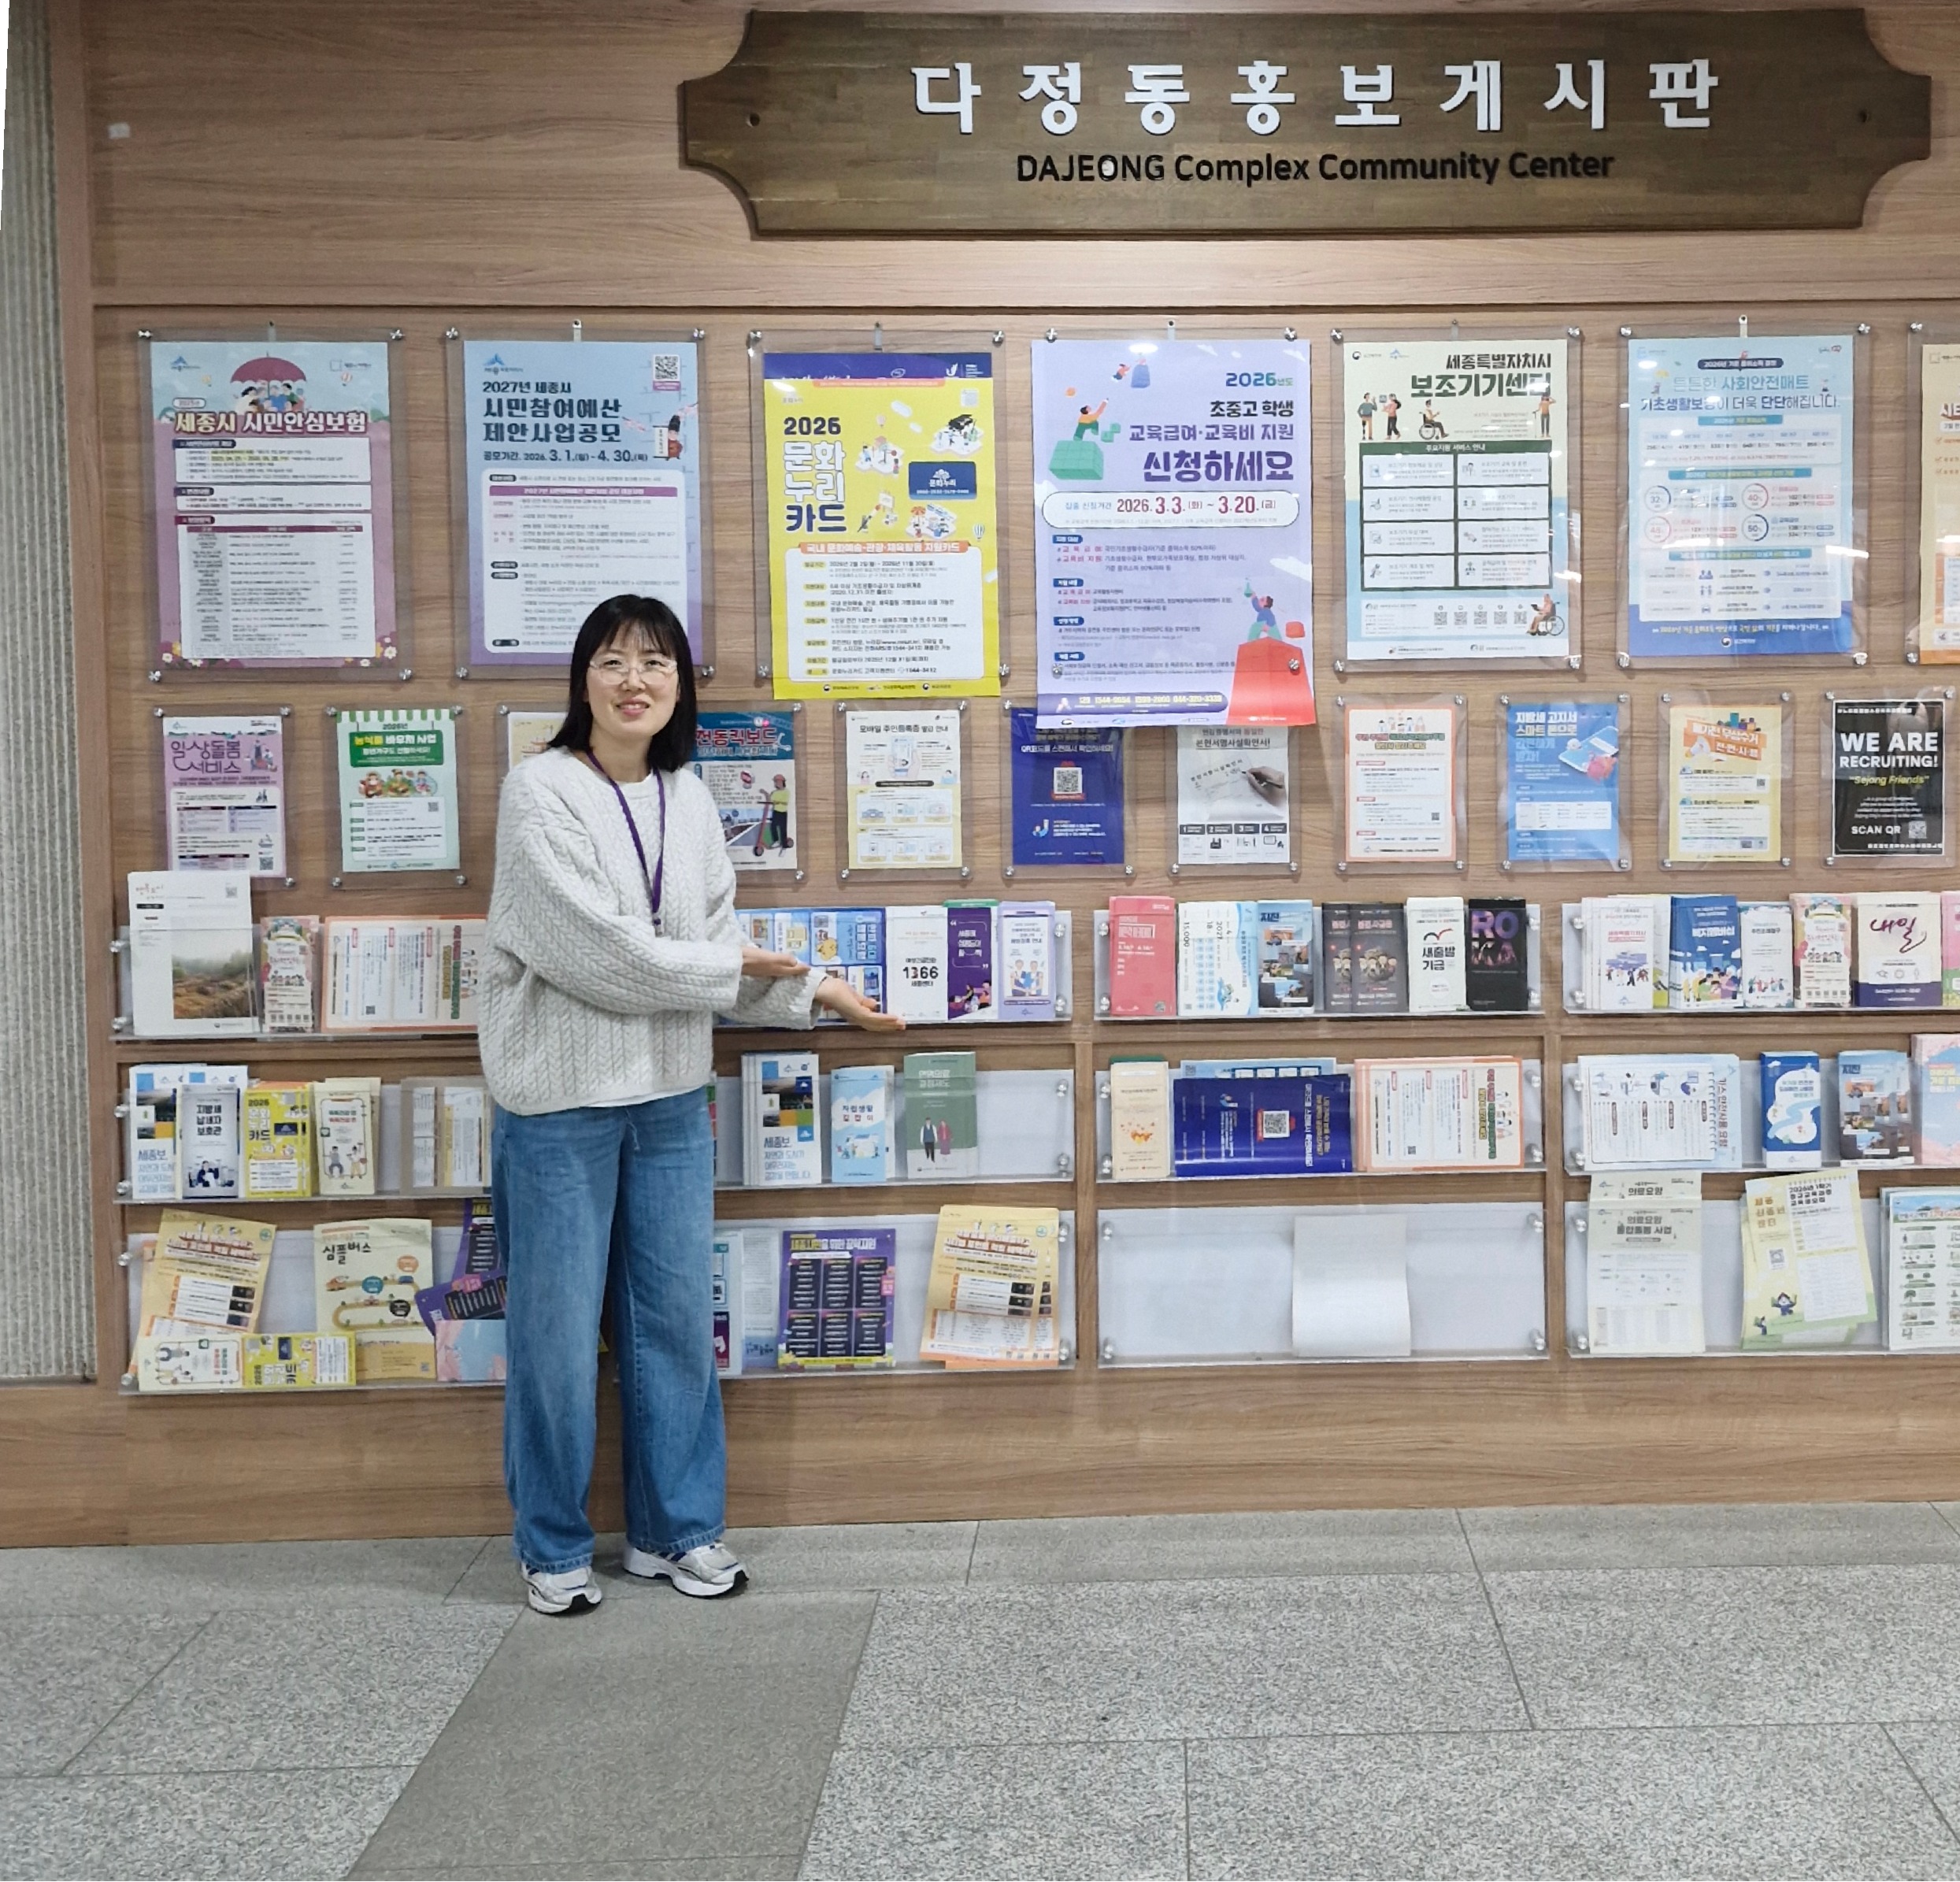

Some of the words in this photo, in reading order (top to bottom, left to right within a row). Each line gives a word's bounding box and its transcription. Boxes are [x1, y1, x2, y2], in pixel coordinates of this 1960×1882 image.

[1015, 153, 1166, 182] DAJEONG
[1174, 151, 1310, 187] Complex
[1317, 150, 1500, 186] Community
[1508, 151, 1616, 180] Center
[1445, 353, 1551, 370] 세종특별자치시
[482, 381, 532, 395] 2027년
[535, 380, 572, 395] 세종시
[1673, 376, 1717, 392] 든든한
[1721, 375, 1810, 391] 사회안전매트
[484, 398, 622, 420] 시민참여예산
[1210, 400, 1258, 418] 초중고
[1262, 400, 1294, 417] 학생
[1732, 396, 1758, 410] 더욱
[175, 412, 236, 434] 세종시
[243, 410, 368, 434] 시민안심보험
[783, 417, 842, 436] 2026
[484, 421, 621, 443] 제안사업공모
[1128, 424, 1255, 442] 교육급여·교육비
[1261, 424, 1294, 441] 지원
[783, 440, 847, 474] 문화
[1143, 450, 1294, 482] 신청하세요
[784, 472, 847, 503] 누리
[786, 504, 847, 533] 카드
[1515, 712, 1546, 724] 지방세
[1547, 711, 1577, 724] 고지서
[696, 727, 778, 747] 전동킥보드
[859, 724, 881, 733] 모바일
[1515, 724, 1546, 736] 스마트
[1721, 728, 1759, 746] 무상수거
[385, 735, 415, 745] 바우처
[417, 733, 437, 744] 사업
[1840, 732, 1880, 752] WE
[1887, 732, 1939, 752] ARE
[170, 740, 241, 760] 일상돌봄
[173, 757, 242, 774] 서비스
[1840, 755, 1939, 769] RECRUITING!
[1851, 824, 1883, 835] SCAN
[1885, 825, 1902, 835] QR
[1471, 910, 1519, 939] RO
[1421, 946, 1455, 958] 새출발
[902, 966, 939, 980] 1366
[1422, 959, 1445, 971] 기금
[1718, 1077, 1728, 1094] 가스
[196, 1104, 221, 1114] 지방세
[197, 1126, 221, 1136] 보호관
[249, 1129, 271, 1140] 카드
[1788, 1184, 1814, 1193] 2026년
[322, 1242, 372, 1265] 심플버스
